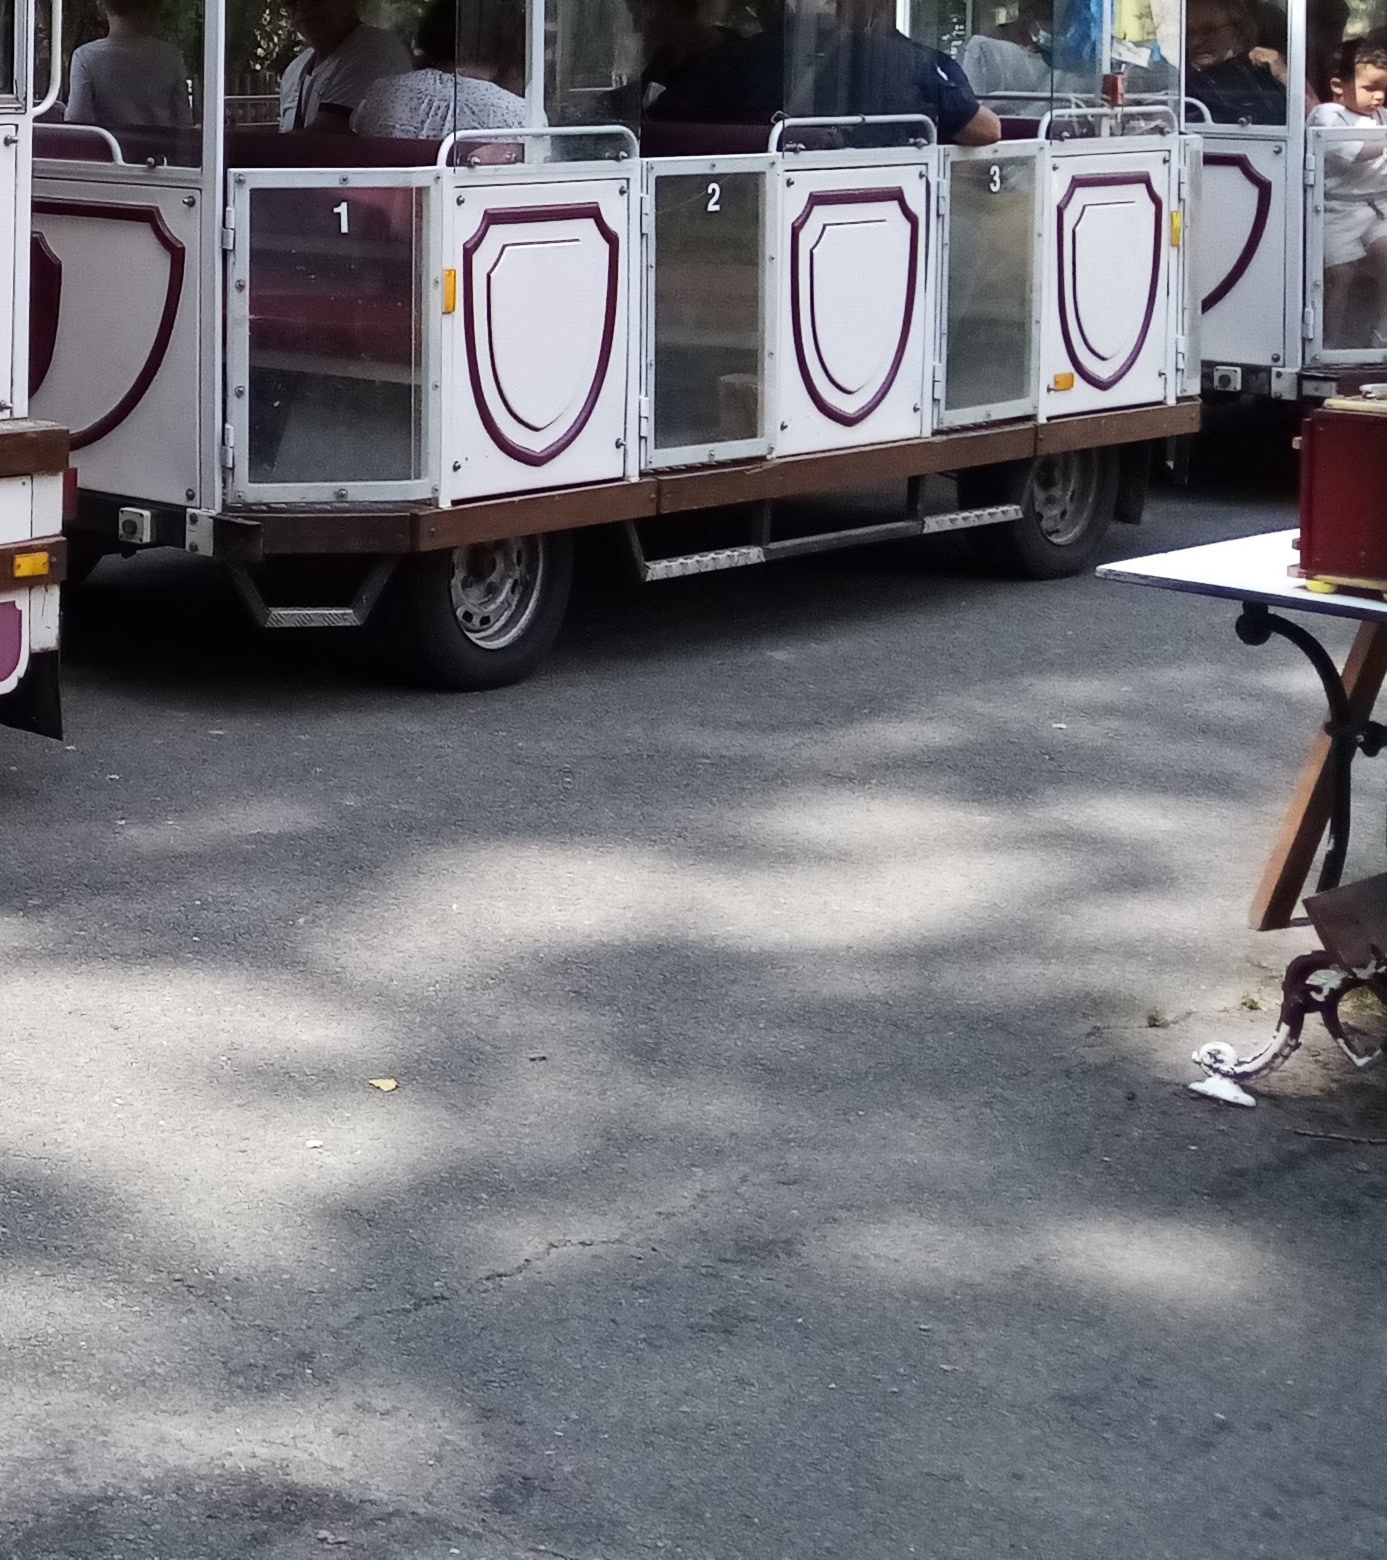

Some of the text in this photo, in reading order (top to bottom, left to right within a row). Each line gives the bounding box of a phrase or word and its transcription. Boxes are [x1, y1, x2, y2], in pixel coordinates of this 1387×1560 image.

[989, 165, 1001, 192] 3
[707, 182, 720, 211] 2
[333, 201, 348, 233] 1
